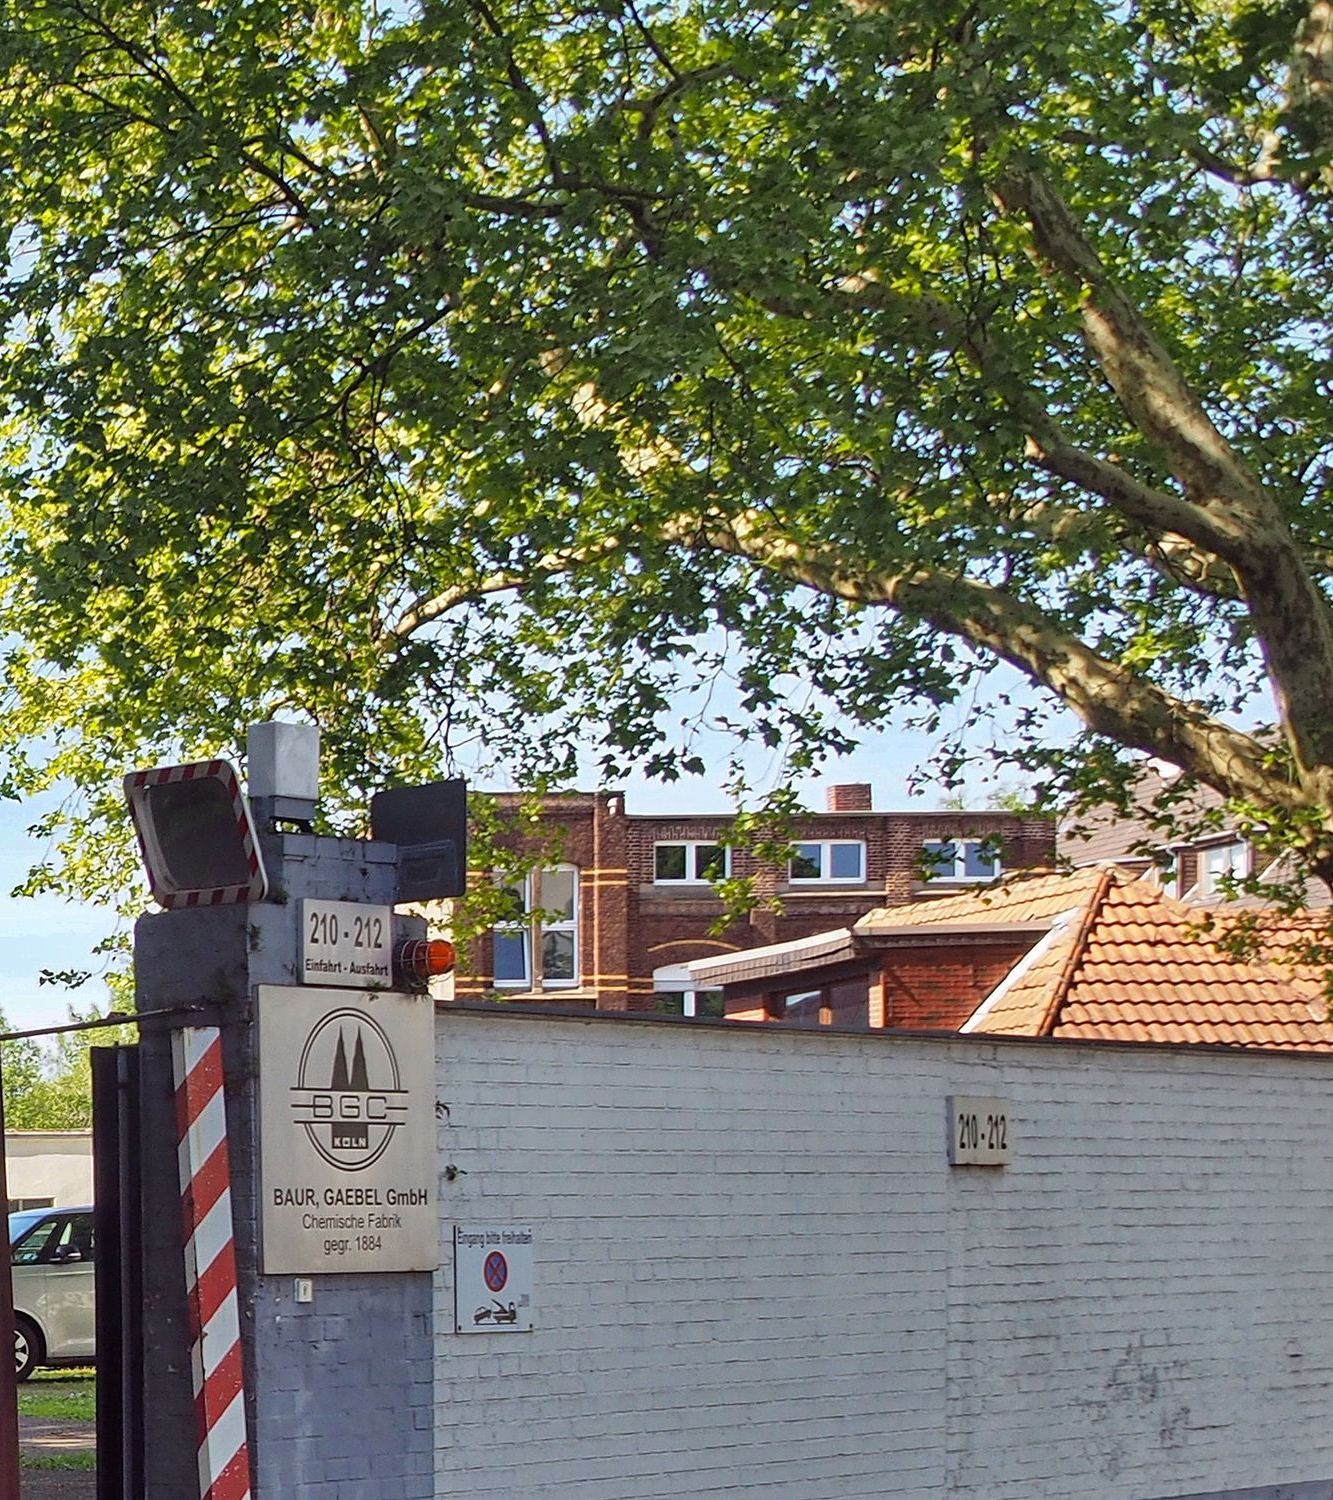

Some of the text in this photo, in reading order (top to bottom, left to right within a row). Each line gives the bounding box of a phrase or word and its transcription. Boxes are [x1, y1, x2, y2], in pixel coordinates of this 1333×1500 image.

[309, 911, 339, 946] 210
[353, 915, 383, 949] 212
[305, 958, 342, 973] Einfahrt
[348, 961, 389, 977] Ausfahrt
[312, 1095, 387, 1119] BGC
[958, 1113, 978, 1149] 210
[987, 1114, 1007, 1149] 212
[273, 1188, 428, 1208] BAUR, GAEBEL GmbH
[302, 1213, 401, 1229] Chemische Fabrik
[323, 1235, 382, 1256] gegr. 1884
